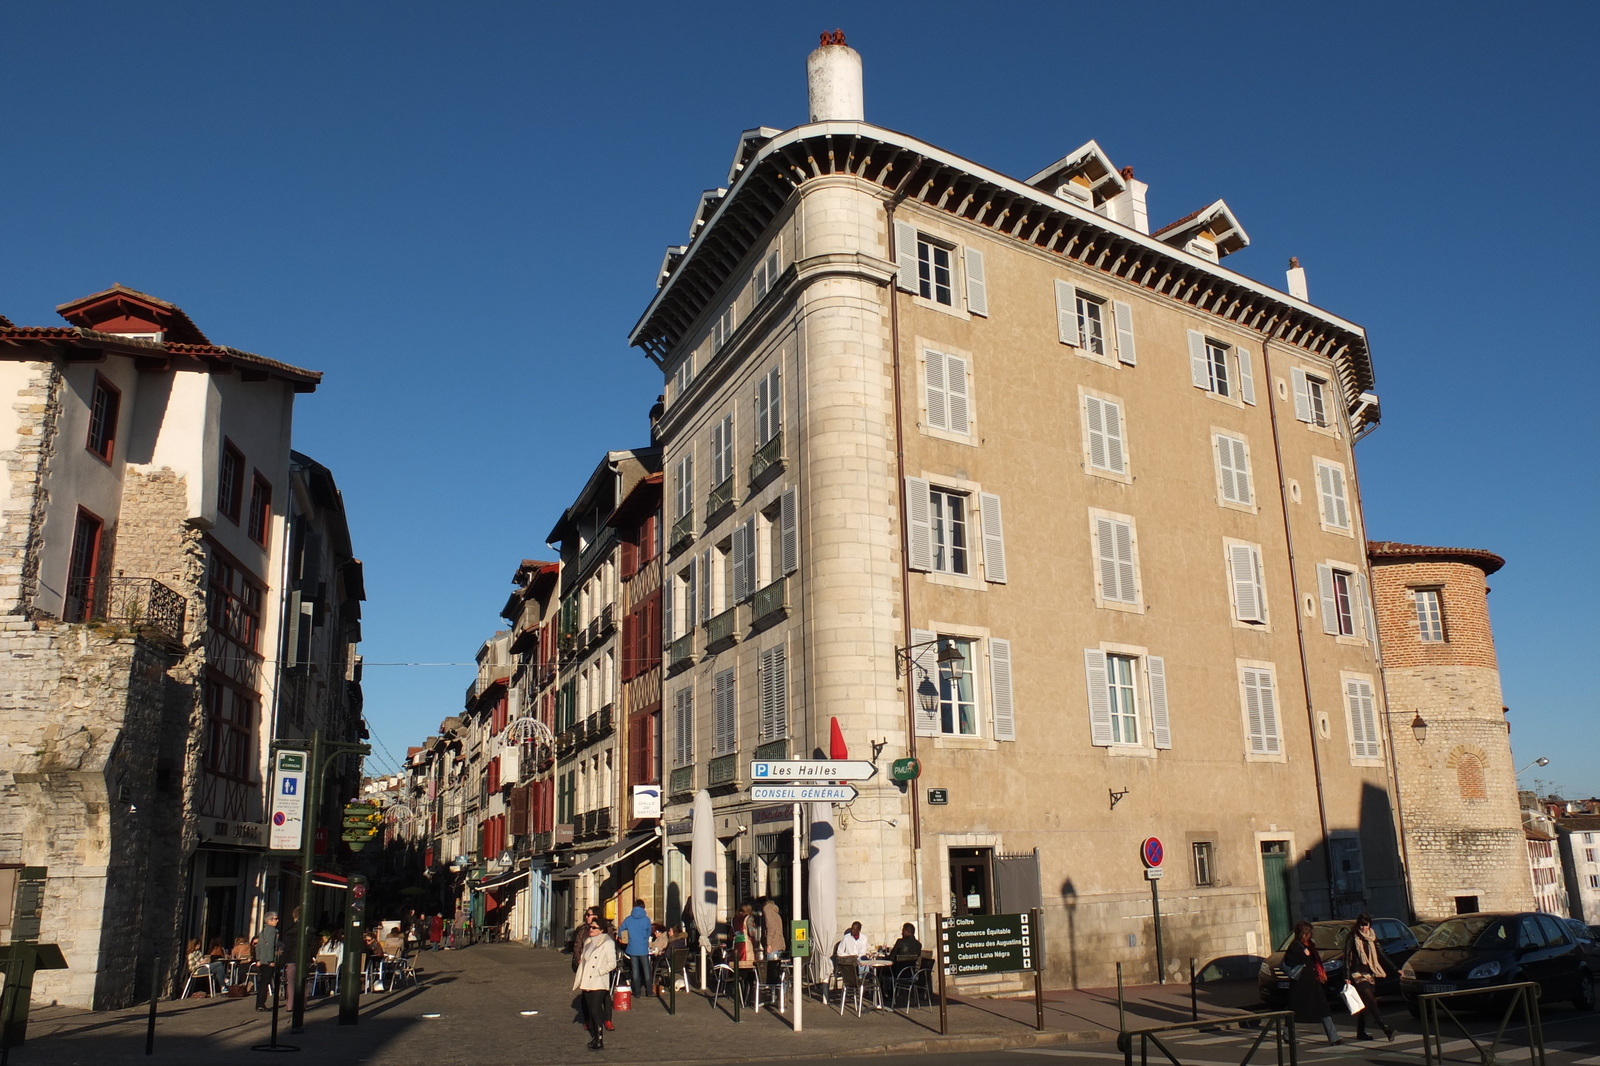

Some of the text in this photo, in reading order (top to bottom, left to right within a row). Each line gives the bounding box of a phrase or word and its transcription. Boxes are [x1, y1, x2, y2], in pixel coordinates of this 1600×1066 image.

[772, 766, 792, 775] Les
[798, 765, 837, 775] Halles
[755, 788, 845, 798] CONSEIL GÉNÉRAL
[987, 928, 1011, 936] Équitable
[959, 964, 988, 972] Cathédrale
